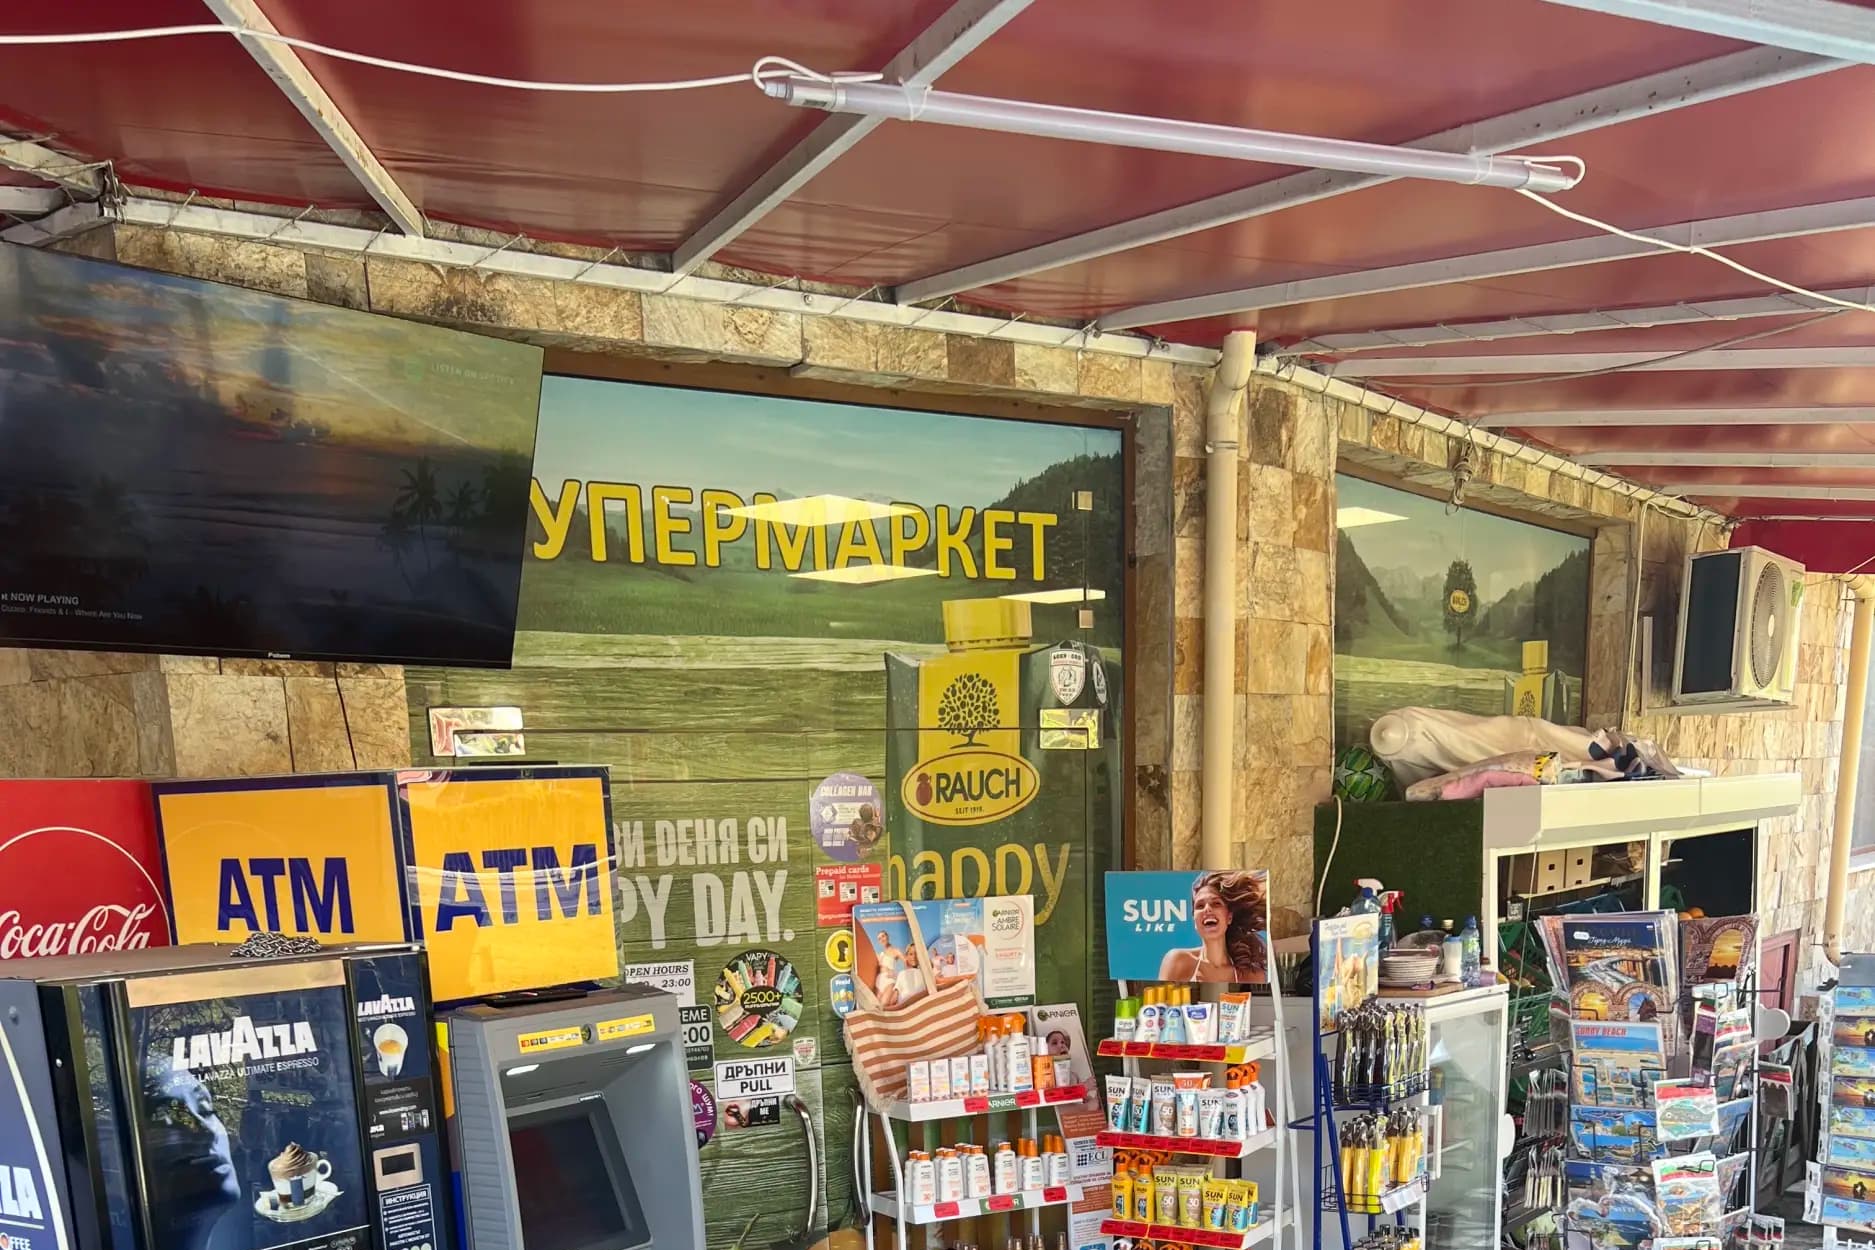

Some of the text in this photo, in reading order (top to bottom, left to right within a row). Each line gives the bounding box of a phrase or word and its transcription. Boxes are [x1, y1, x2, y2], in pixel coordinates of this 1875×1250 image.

[10, 593, 80, 606] NOW PLAYING
[935, 767, 1021, 804] RAUCH
[816, 867, 847, 877] Prepaid
[888, 832, 1071, 927] happy
[435, 843, 603, 933] ATM
[217, 857, 355, 934] ATM
[1123, 898, 1188, 923] SUN
[0, 903, 156, 961] Coca-Cola
[1135, 923, 1176, 933] LIKE
[652, 964, 689, 976] HOURS
[661, 978, 691, 988] 23:00
[743, 990, 782, 1005] 2500+
[357, 994, 416, 1017] LAVAZZA
[172, 1015, 318, 1072] LAVAZZA
[237, 1063, 276, 1078] ULTIMATE
[276, 1056, 320, 1072] ESPRESSO
[725, 1061, 786, 1080] ДРЪПНИ
[740, 1079, 773, 1093] PULL
[1107, 1086, 1126, 1094] SUN
[1154, 1085, 1175, 1093] SUN
[1155, 1175, 1175, 1184] SUN
[1180, 1177, 1200, 1186] SUN
[1204, 1190, 1224, 1199] SUN
[1228, 1191, 1243, 1201] SUN
